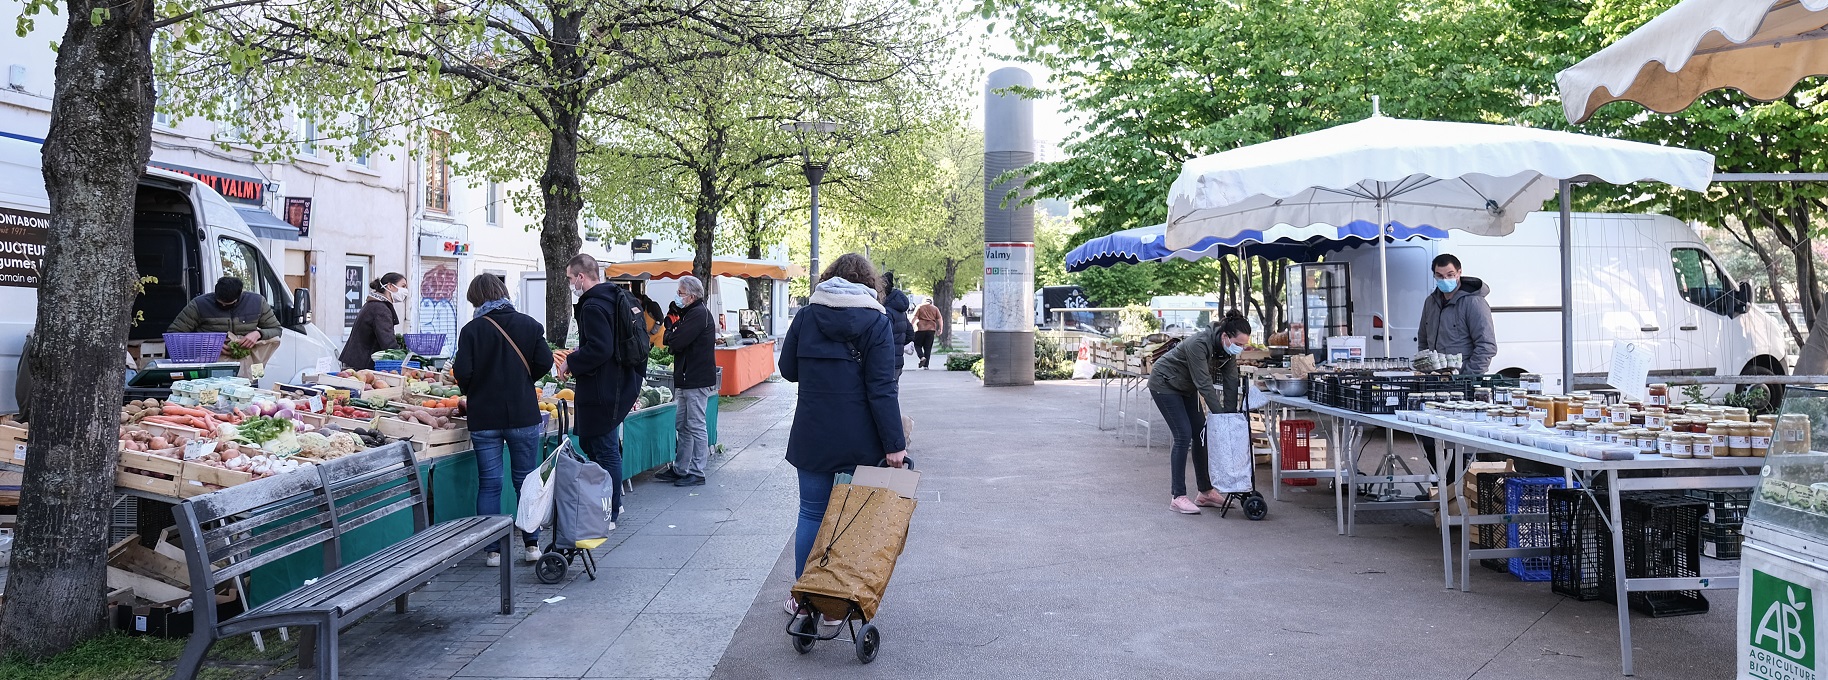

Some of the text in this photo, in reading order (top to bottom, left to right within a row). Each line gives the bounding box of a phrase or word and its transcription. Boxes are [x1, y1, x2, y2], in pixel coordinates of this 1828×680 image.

[221, 177, 262, 199] VALMY
[986, 250, 1011, 261] Valmy
[1755, 600, 1806, 660] AB
[1749, 649, 1816, 680] AGRICULTURE
